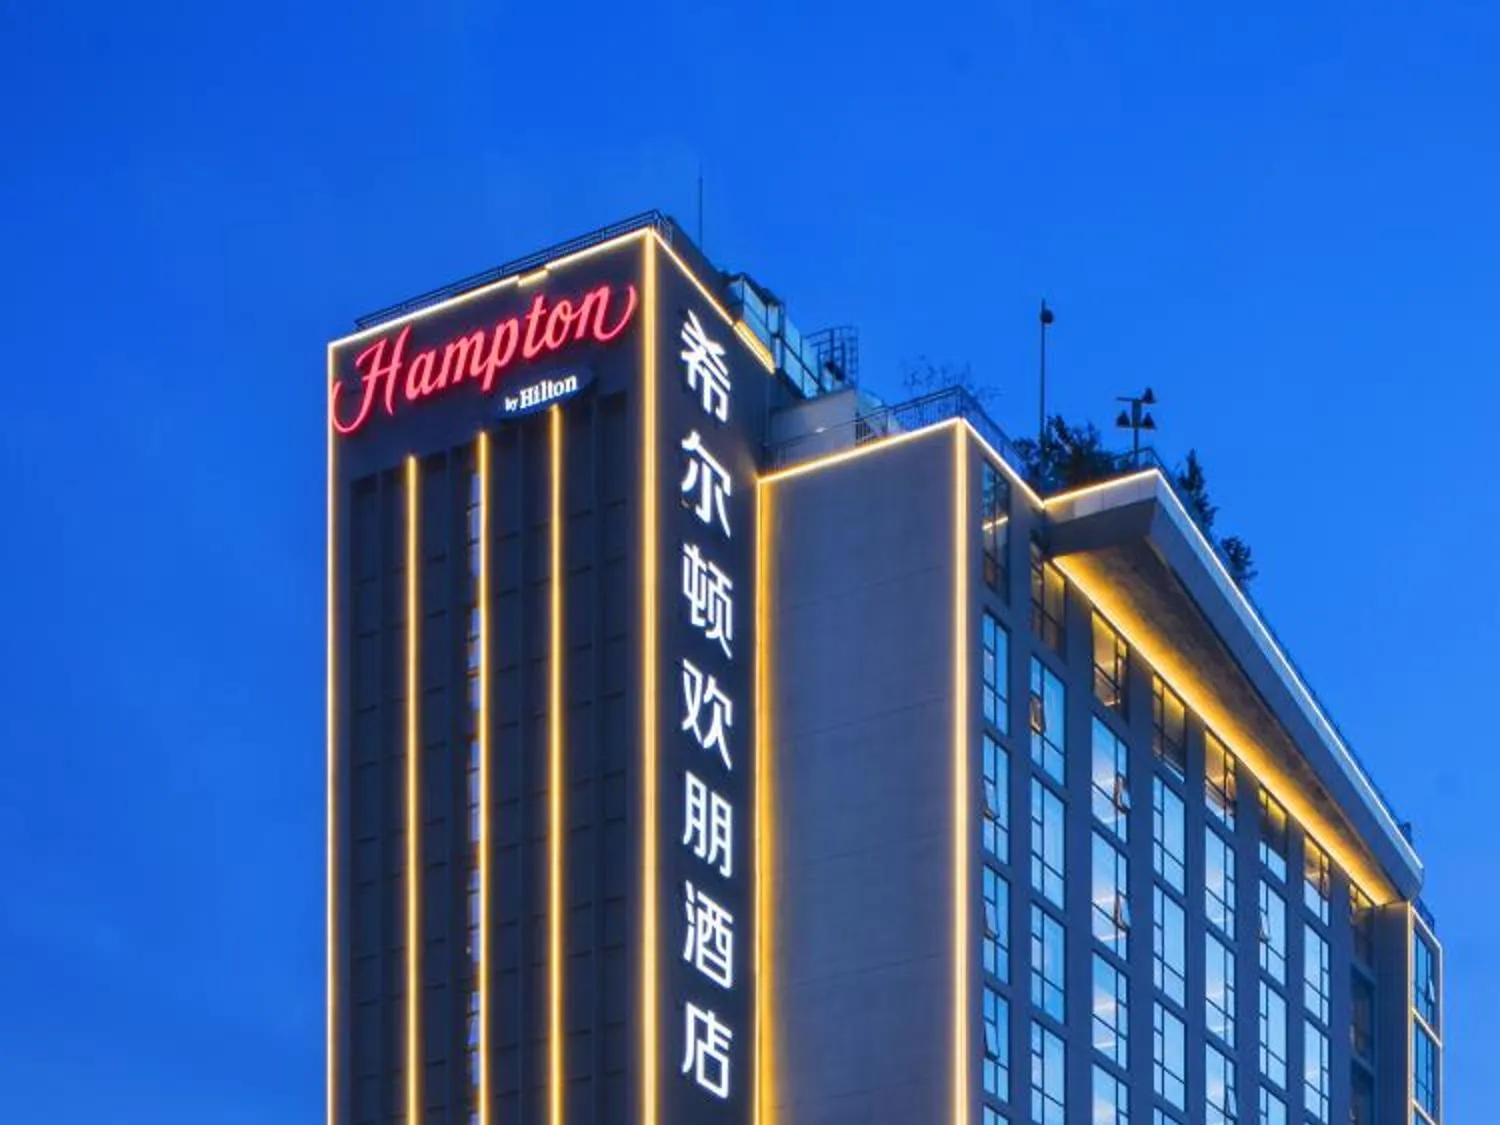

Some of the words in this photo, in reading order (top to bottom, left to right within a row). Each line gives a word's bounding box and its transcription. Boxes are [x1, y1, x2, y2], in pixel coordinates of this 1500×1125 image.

[331, 284, 638, 433] Hampton
[504, 396, 518, 412] by
[518, 374, 578, 409] Hilton
[680, 309, 734, 1100] 希尔顿欢朋酒店
